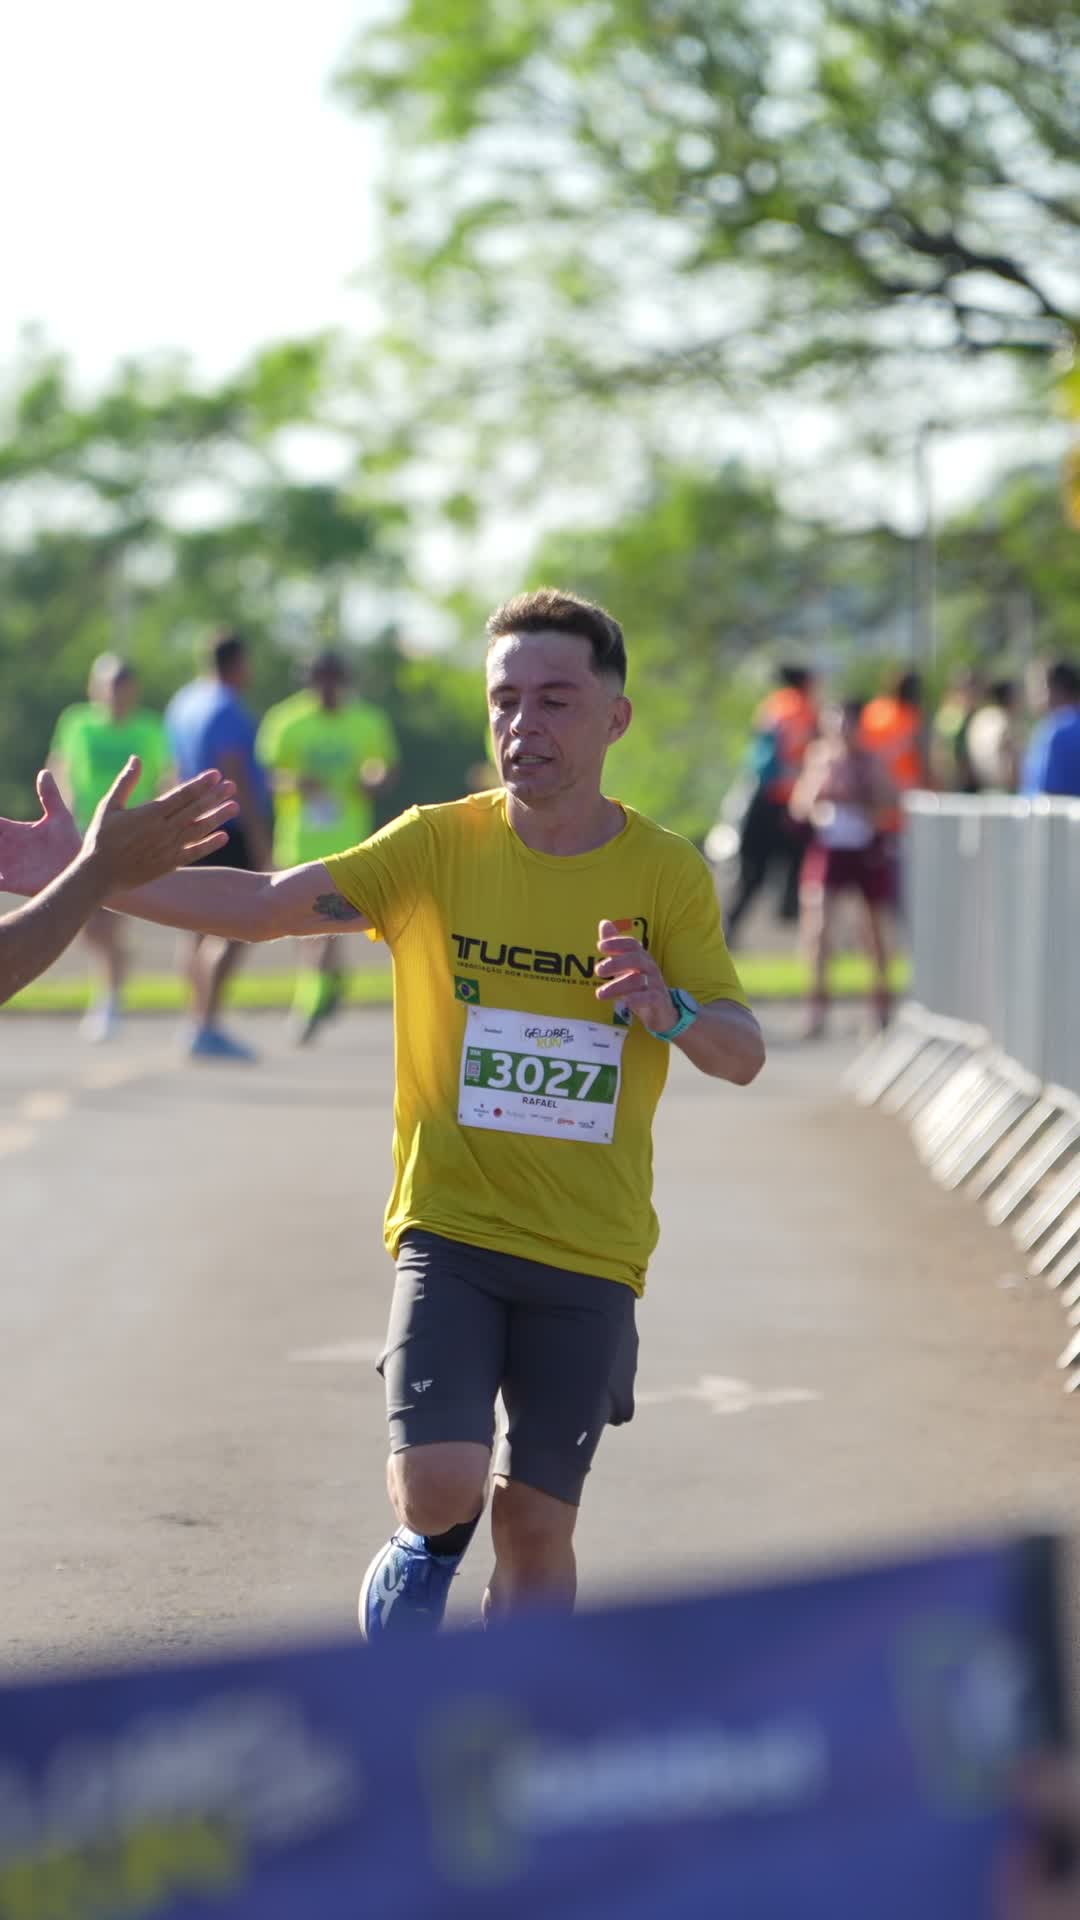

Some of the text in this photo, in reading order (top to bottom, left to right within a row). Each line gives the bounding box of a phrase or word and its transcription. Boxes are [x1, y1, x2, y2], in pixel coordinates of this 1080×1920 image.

[525, 1028, 570, 1038] GELOBEL
[487, 1052, 602, 1099] 3027
[522, 1097, 558, 1109] RAFAEL
